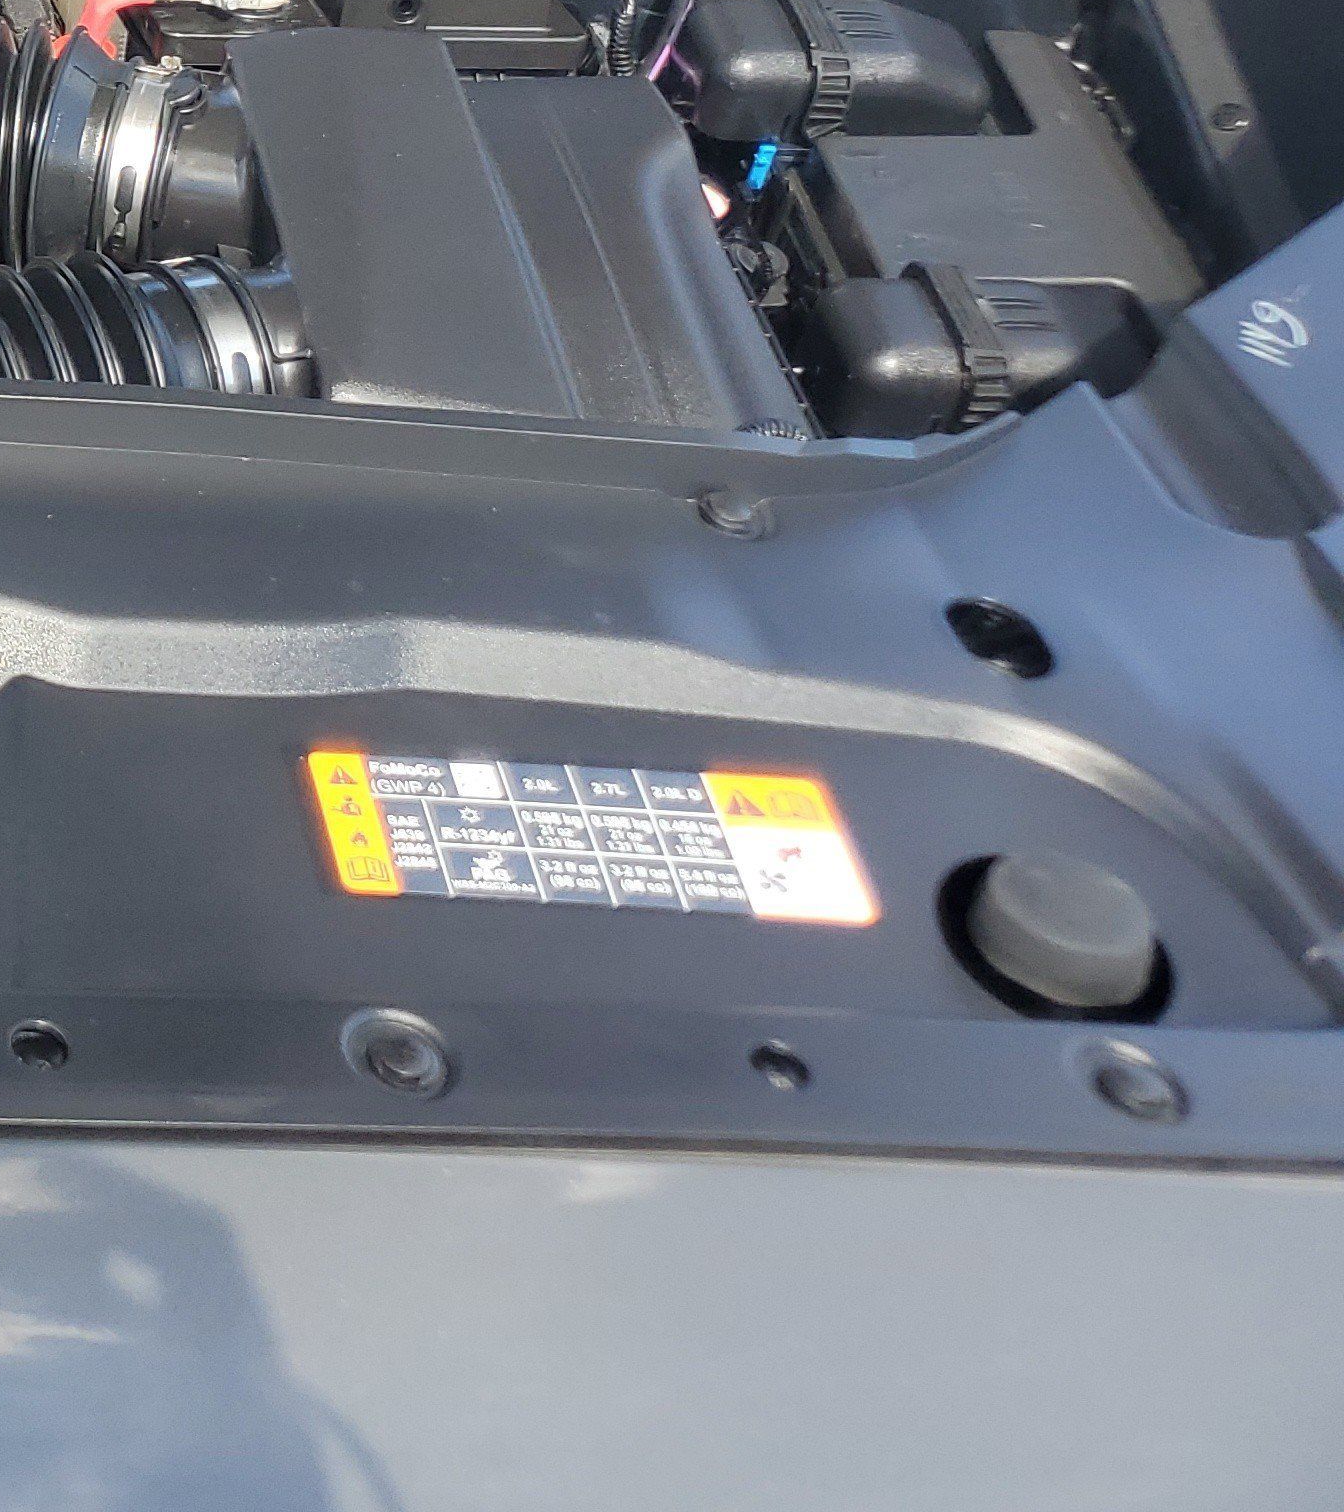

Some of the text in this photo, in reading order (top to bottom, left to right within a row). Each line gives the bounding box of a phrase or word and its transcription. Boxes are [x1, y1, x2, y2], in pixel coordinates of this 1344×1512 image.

[368, 760, 442, 777] FoMoCo
[371, 778, 446, 797] (GWP 4)
[522, 777, 559, 792] 2.0L
[590, 782, 628, 795] 2.7L
[387, 815, 420, 827] SAE
[562, 812, 585, 829] kg
[538, 859, 563, 873] 3.2
[608, 863, 634, 877] 3.2
